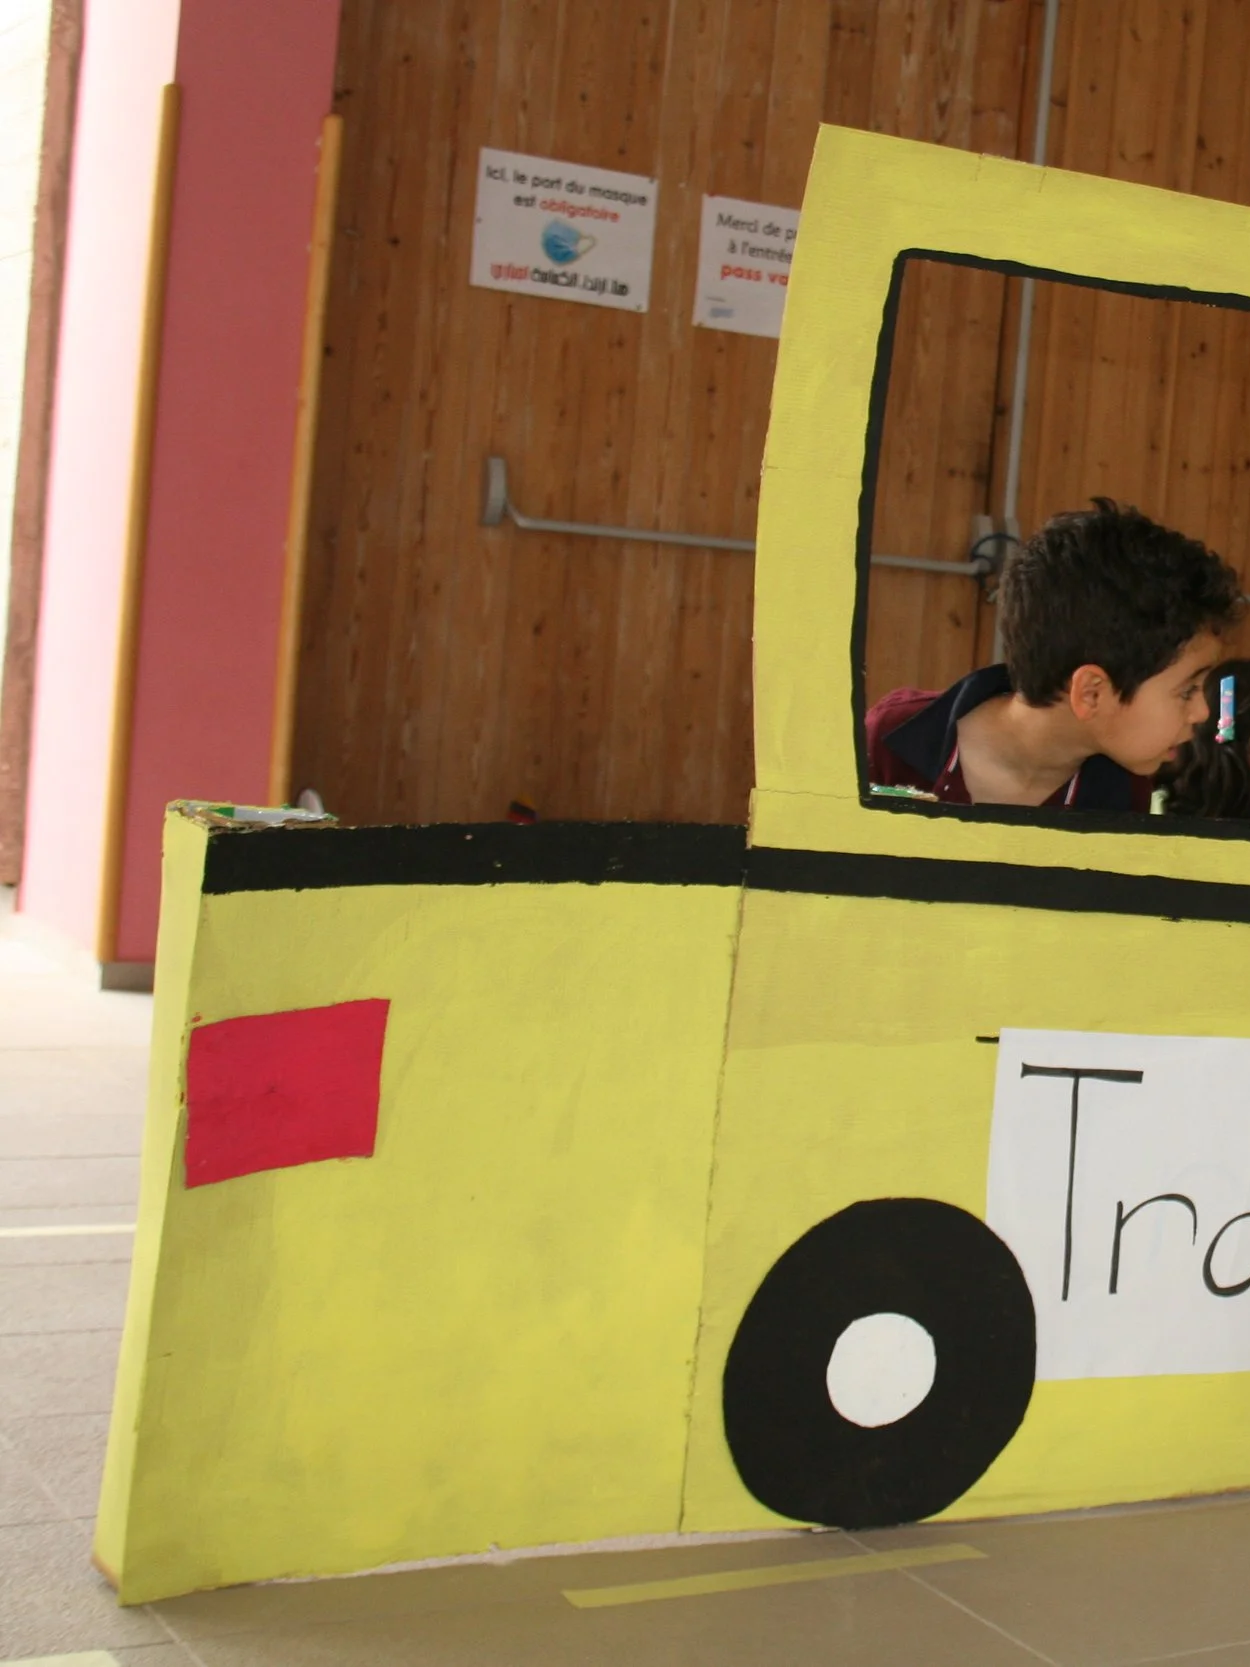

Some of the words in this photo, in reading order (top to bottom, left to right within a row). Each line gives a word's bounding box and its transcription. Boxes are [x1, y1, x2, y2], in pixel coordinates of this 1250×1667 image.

[513, 170, 527, 184] le
[531, 175, 562, 190] port
[565, 181, 585, 194] du
[589, 186, 648, 206] masque
[513, 195, 536, 208] est
[539, 199, 620, 223] obligatoire
[716, 213, 758, 234] Merci
[763, 222, 781, 238] de
[721, 264, 762, 282] pass
